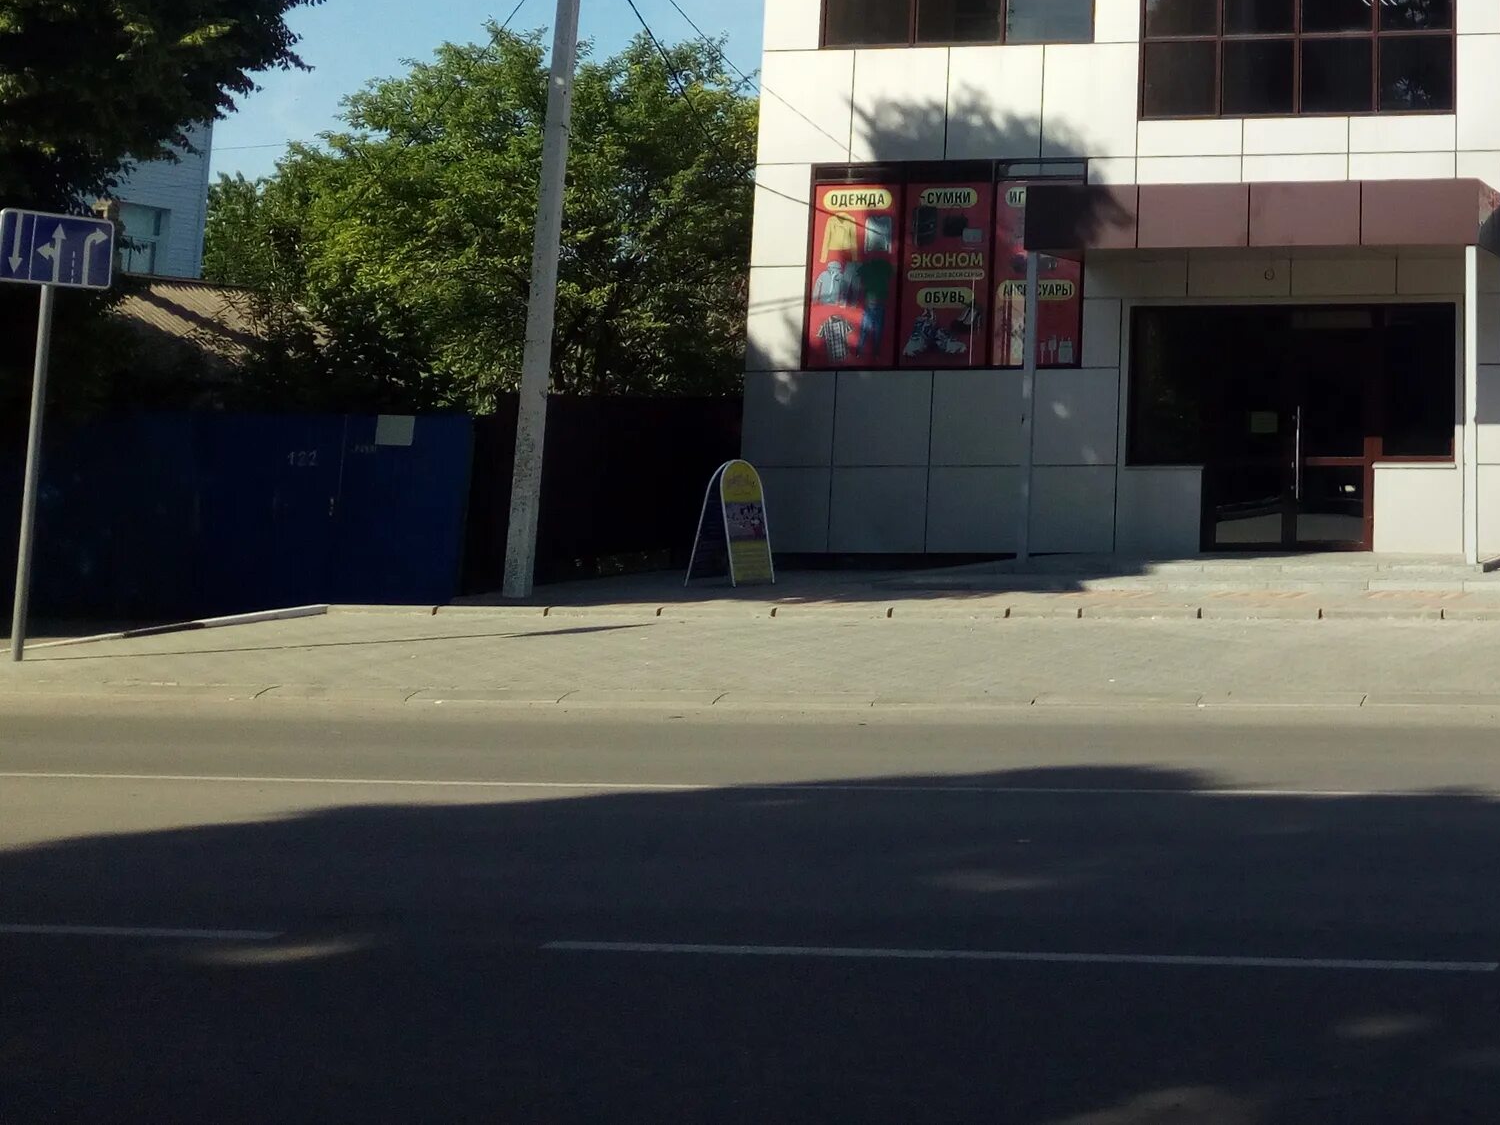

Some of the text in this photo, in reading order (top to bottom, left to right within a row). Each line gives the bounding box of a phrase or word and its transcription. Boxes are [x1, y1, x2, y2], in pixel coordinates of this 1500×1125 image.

[829, 193, 886, 208] ОДЕЖДА
[926, 191, 972, 205] СУМКИ
[910, 252, 984, 268] ЭКОНОМ
[925, 291, 965, 304] ОБУВЬ
